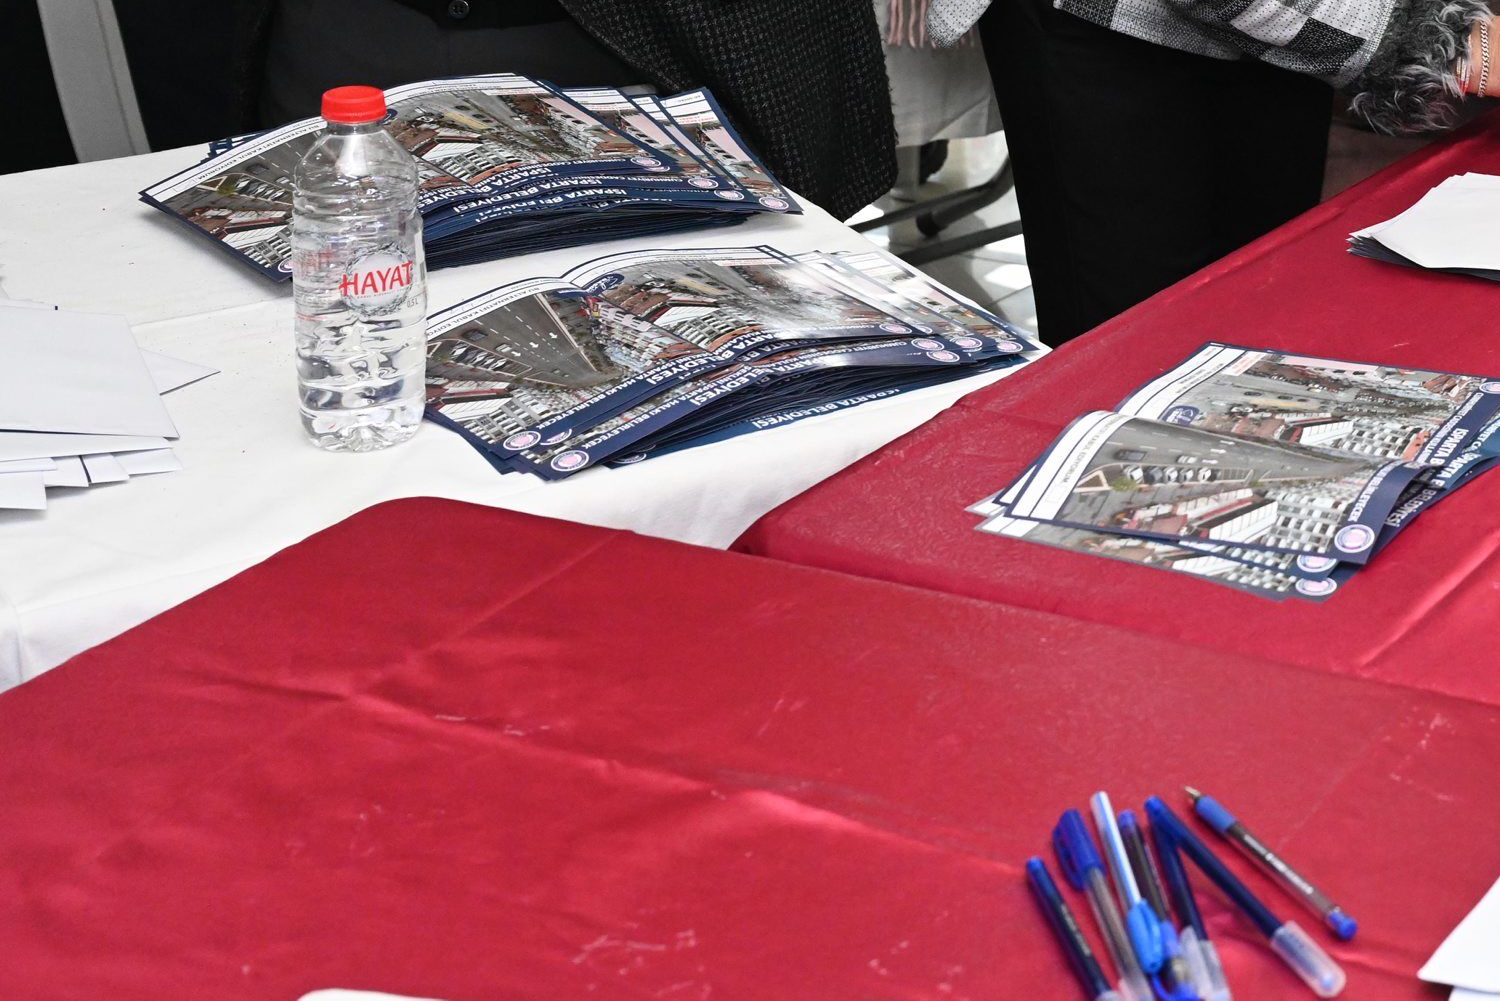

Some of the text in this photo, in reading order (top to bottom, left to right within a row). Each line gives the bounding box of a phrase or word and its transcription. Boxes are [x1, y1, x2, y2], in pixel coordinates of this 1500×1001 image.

[491, 167, 552, 187] ISPARTA
[539, 179, 602, 190] ISPARTA
[416, 185, 492, 210] BELEDİYES
[452, 187, 539, 213] BELEDİYESİ
[564, 188, 627, 200] ISPARTA
[339, 260, 413, 297] HAYAT
[645, 349, 735, 385] BELEDİYESİ
[605, 378, 637, 396] HALKI
[535, 394, 607, 430] BELİRLEYECEK
[648, 399, 677, 416] HALKI
[751, 403, 838, 429] BELEDİYESİ
[580, 413, 650, 450] BELİRLEYECEK
